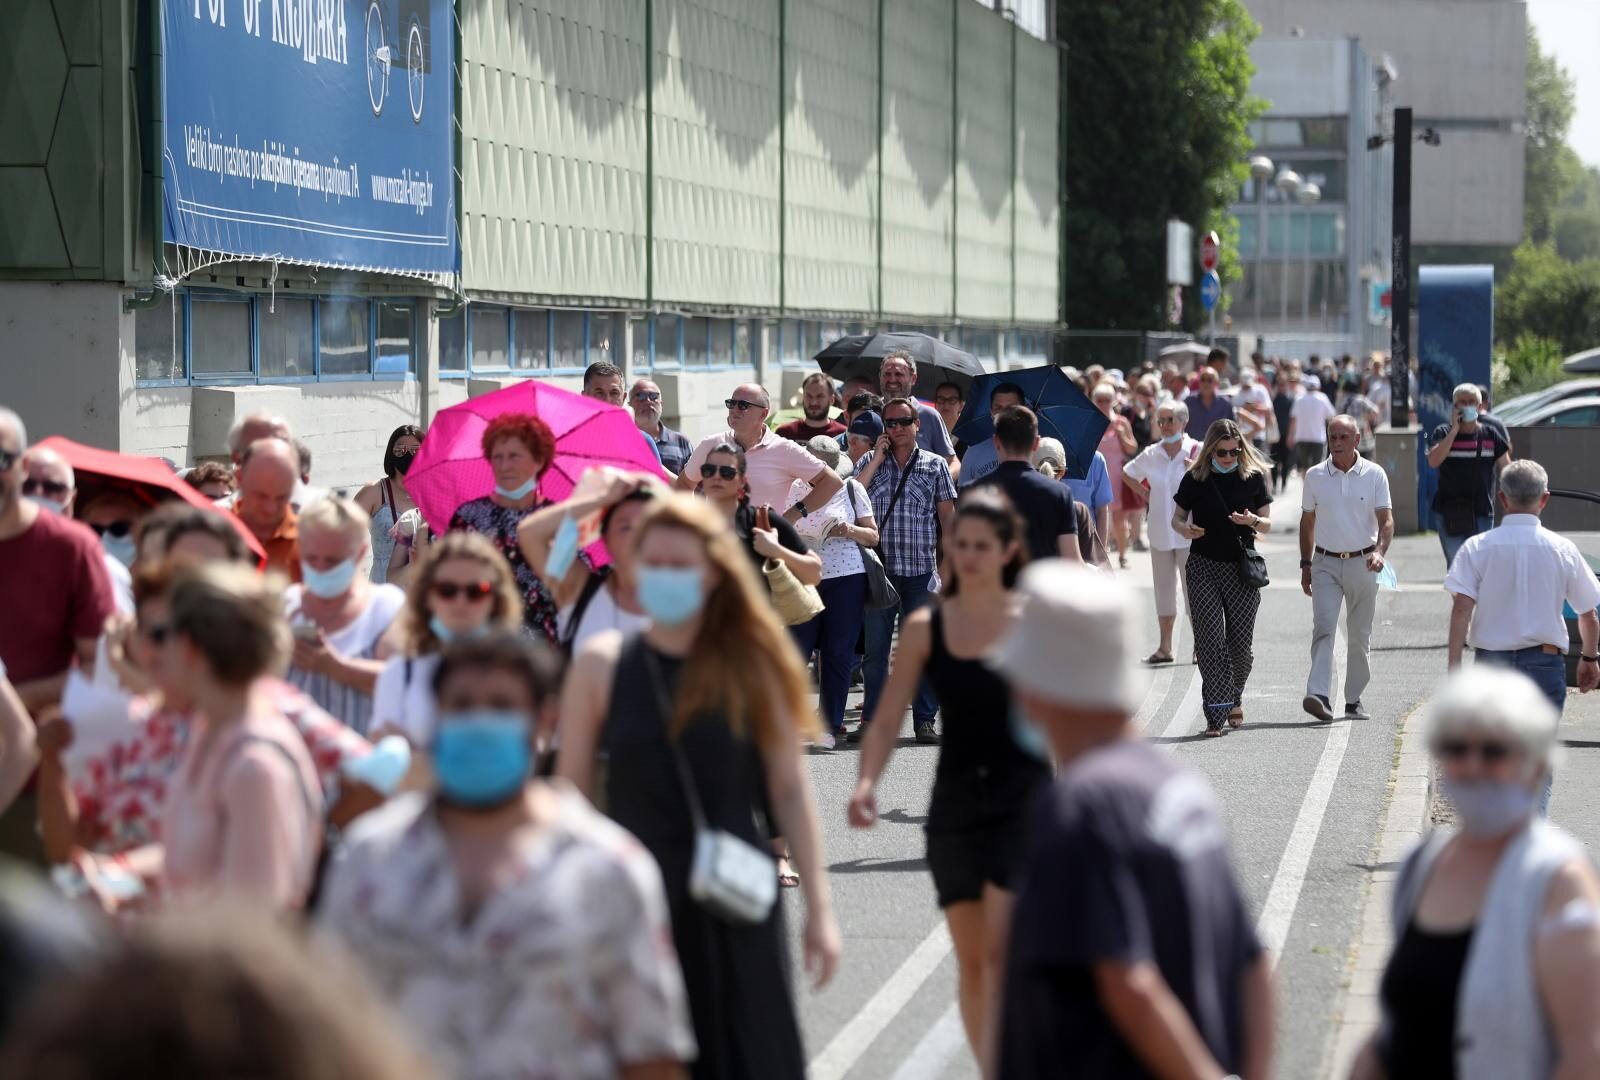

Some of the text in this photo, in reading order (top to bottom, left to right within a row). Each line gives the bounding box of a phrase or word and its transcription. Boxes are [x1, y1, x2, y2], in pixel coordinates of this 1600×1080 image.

[184, 124, 360, 205] Veliki broj naslova po akcijskim cijenama u paviljonu 7A
[371, 168, 433, 216] www.mozaik-knjiga.hr
